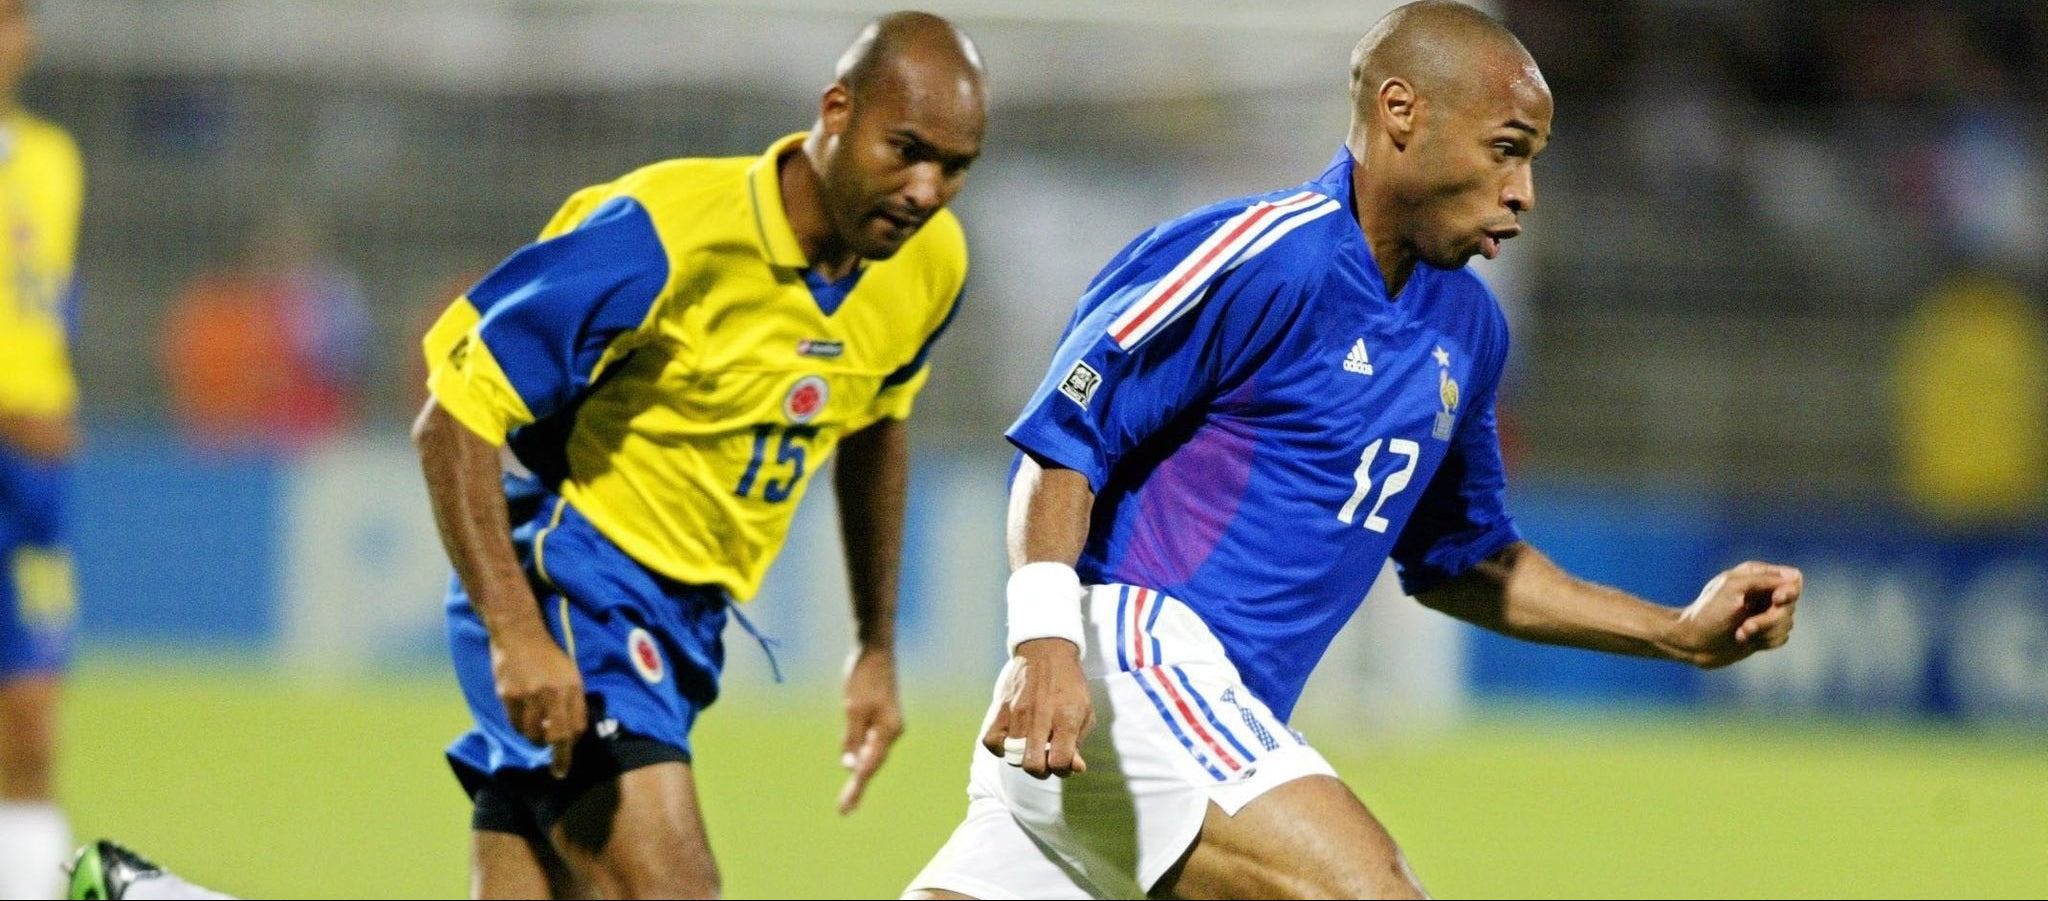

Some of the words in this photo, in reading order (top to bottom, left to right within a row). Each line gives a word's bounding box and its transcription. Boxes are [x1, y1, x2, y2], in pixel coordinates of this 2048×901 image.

[1343, 359, 1374, 376] adidas
[733, 422, 820, 504] 15
[1337, 438, 1419, 533] 12
